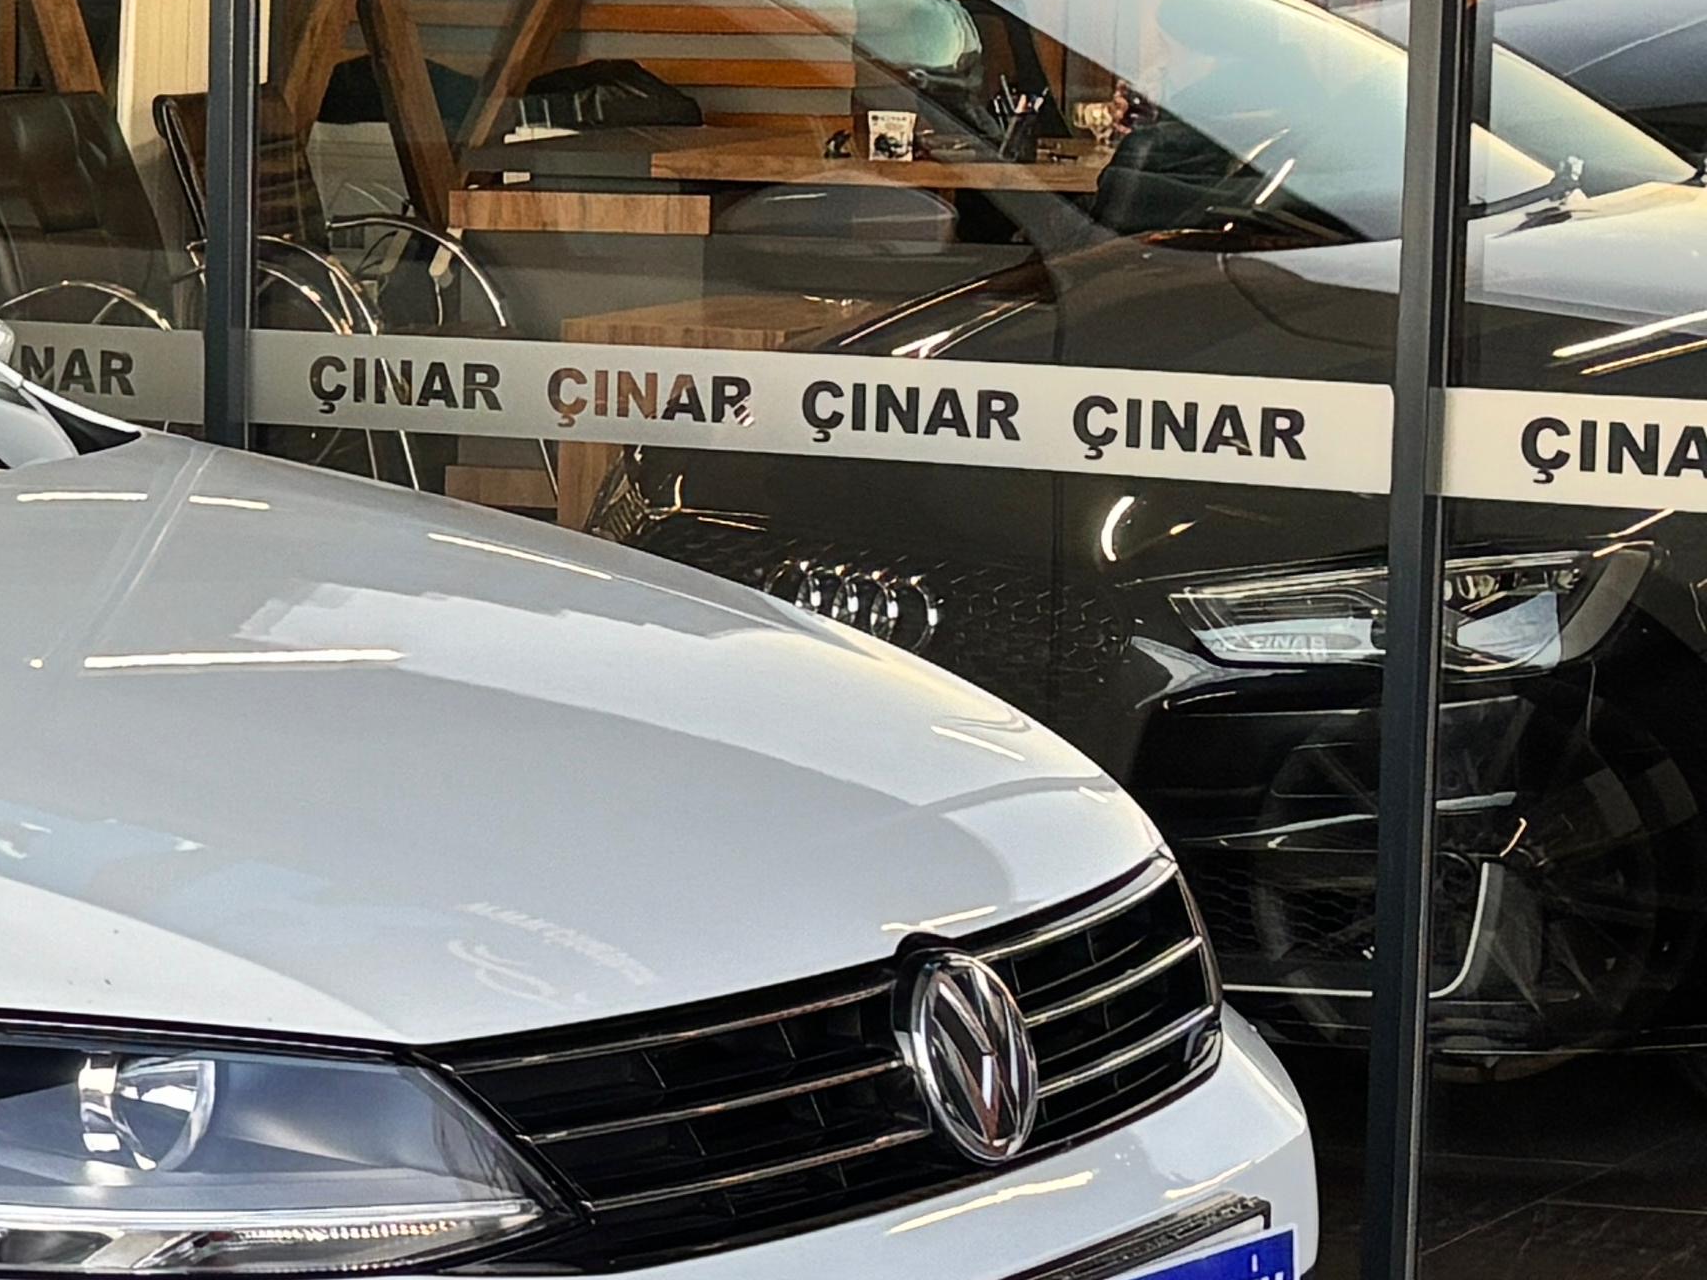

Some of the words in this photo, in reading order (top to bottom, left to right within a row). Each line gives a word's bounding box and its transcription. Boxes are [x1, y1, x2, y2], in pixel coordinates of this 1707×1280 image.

[310, 356, 502, 414] ÇINAR
[548, 368, 753, 428] ÇINAR
[801, 380, 1021, 442] ÇINAR
[1072, 395, 1307, 460] ÇINAR
